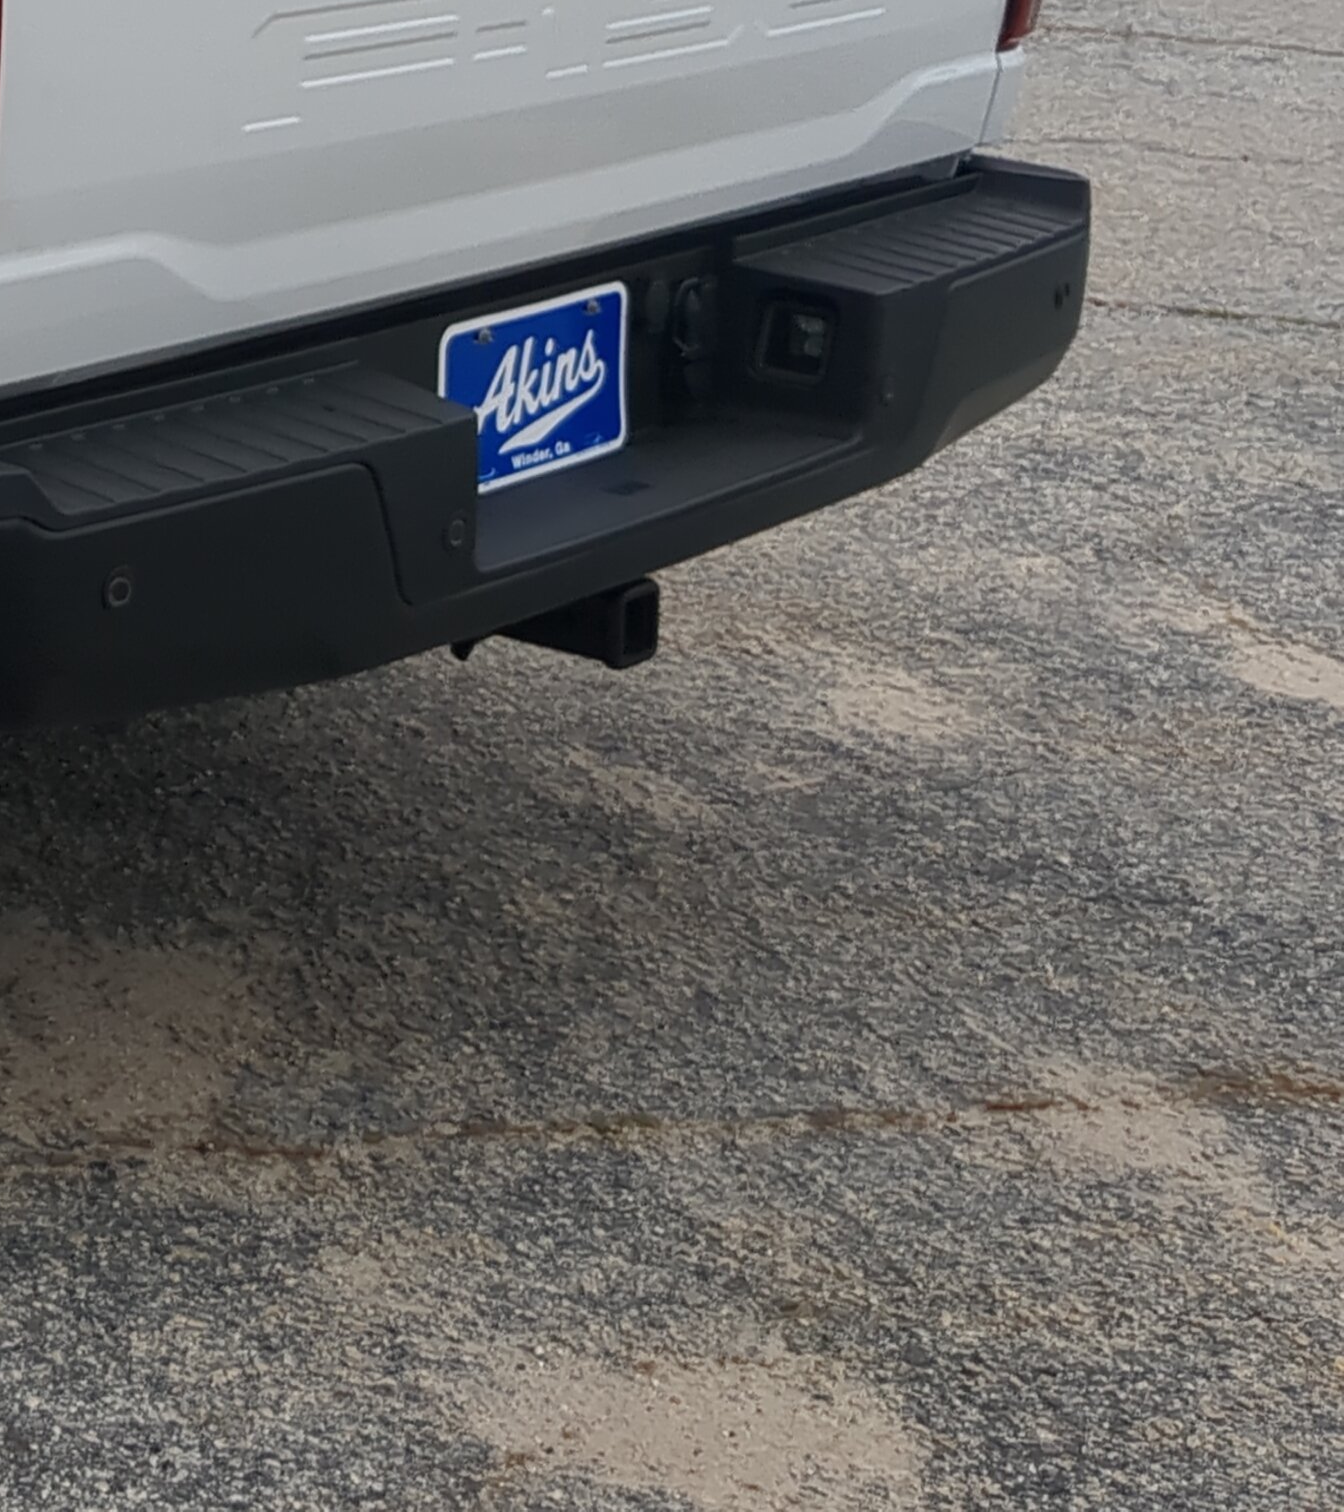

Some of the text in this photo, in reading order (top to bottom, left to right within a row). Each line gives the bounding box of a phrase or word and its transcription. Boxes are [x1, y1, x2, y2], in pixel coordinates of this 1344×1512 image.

[473, 328, 605, 435] Akins
[511, 441, 571, 469] Winder, Ga
